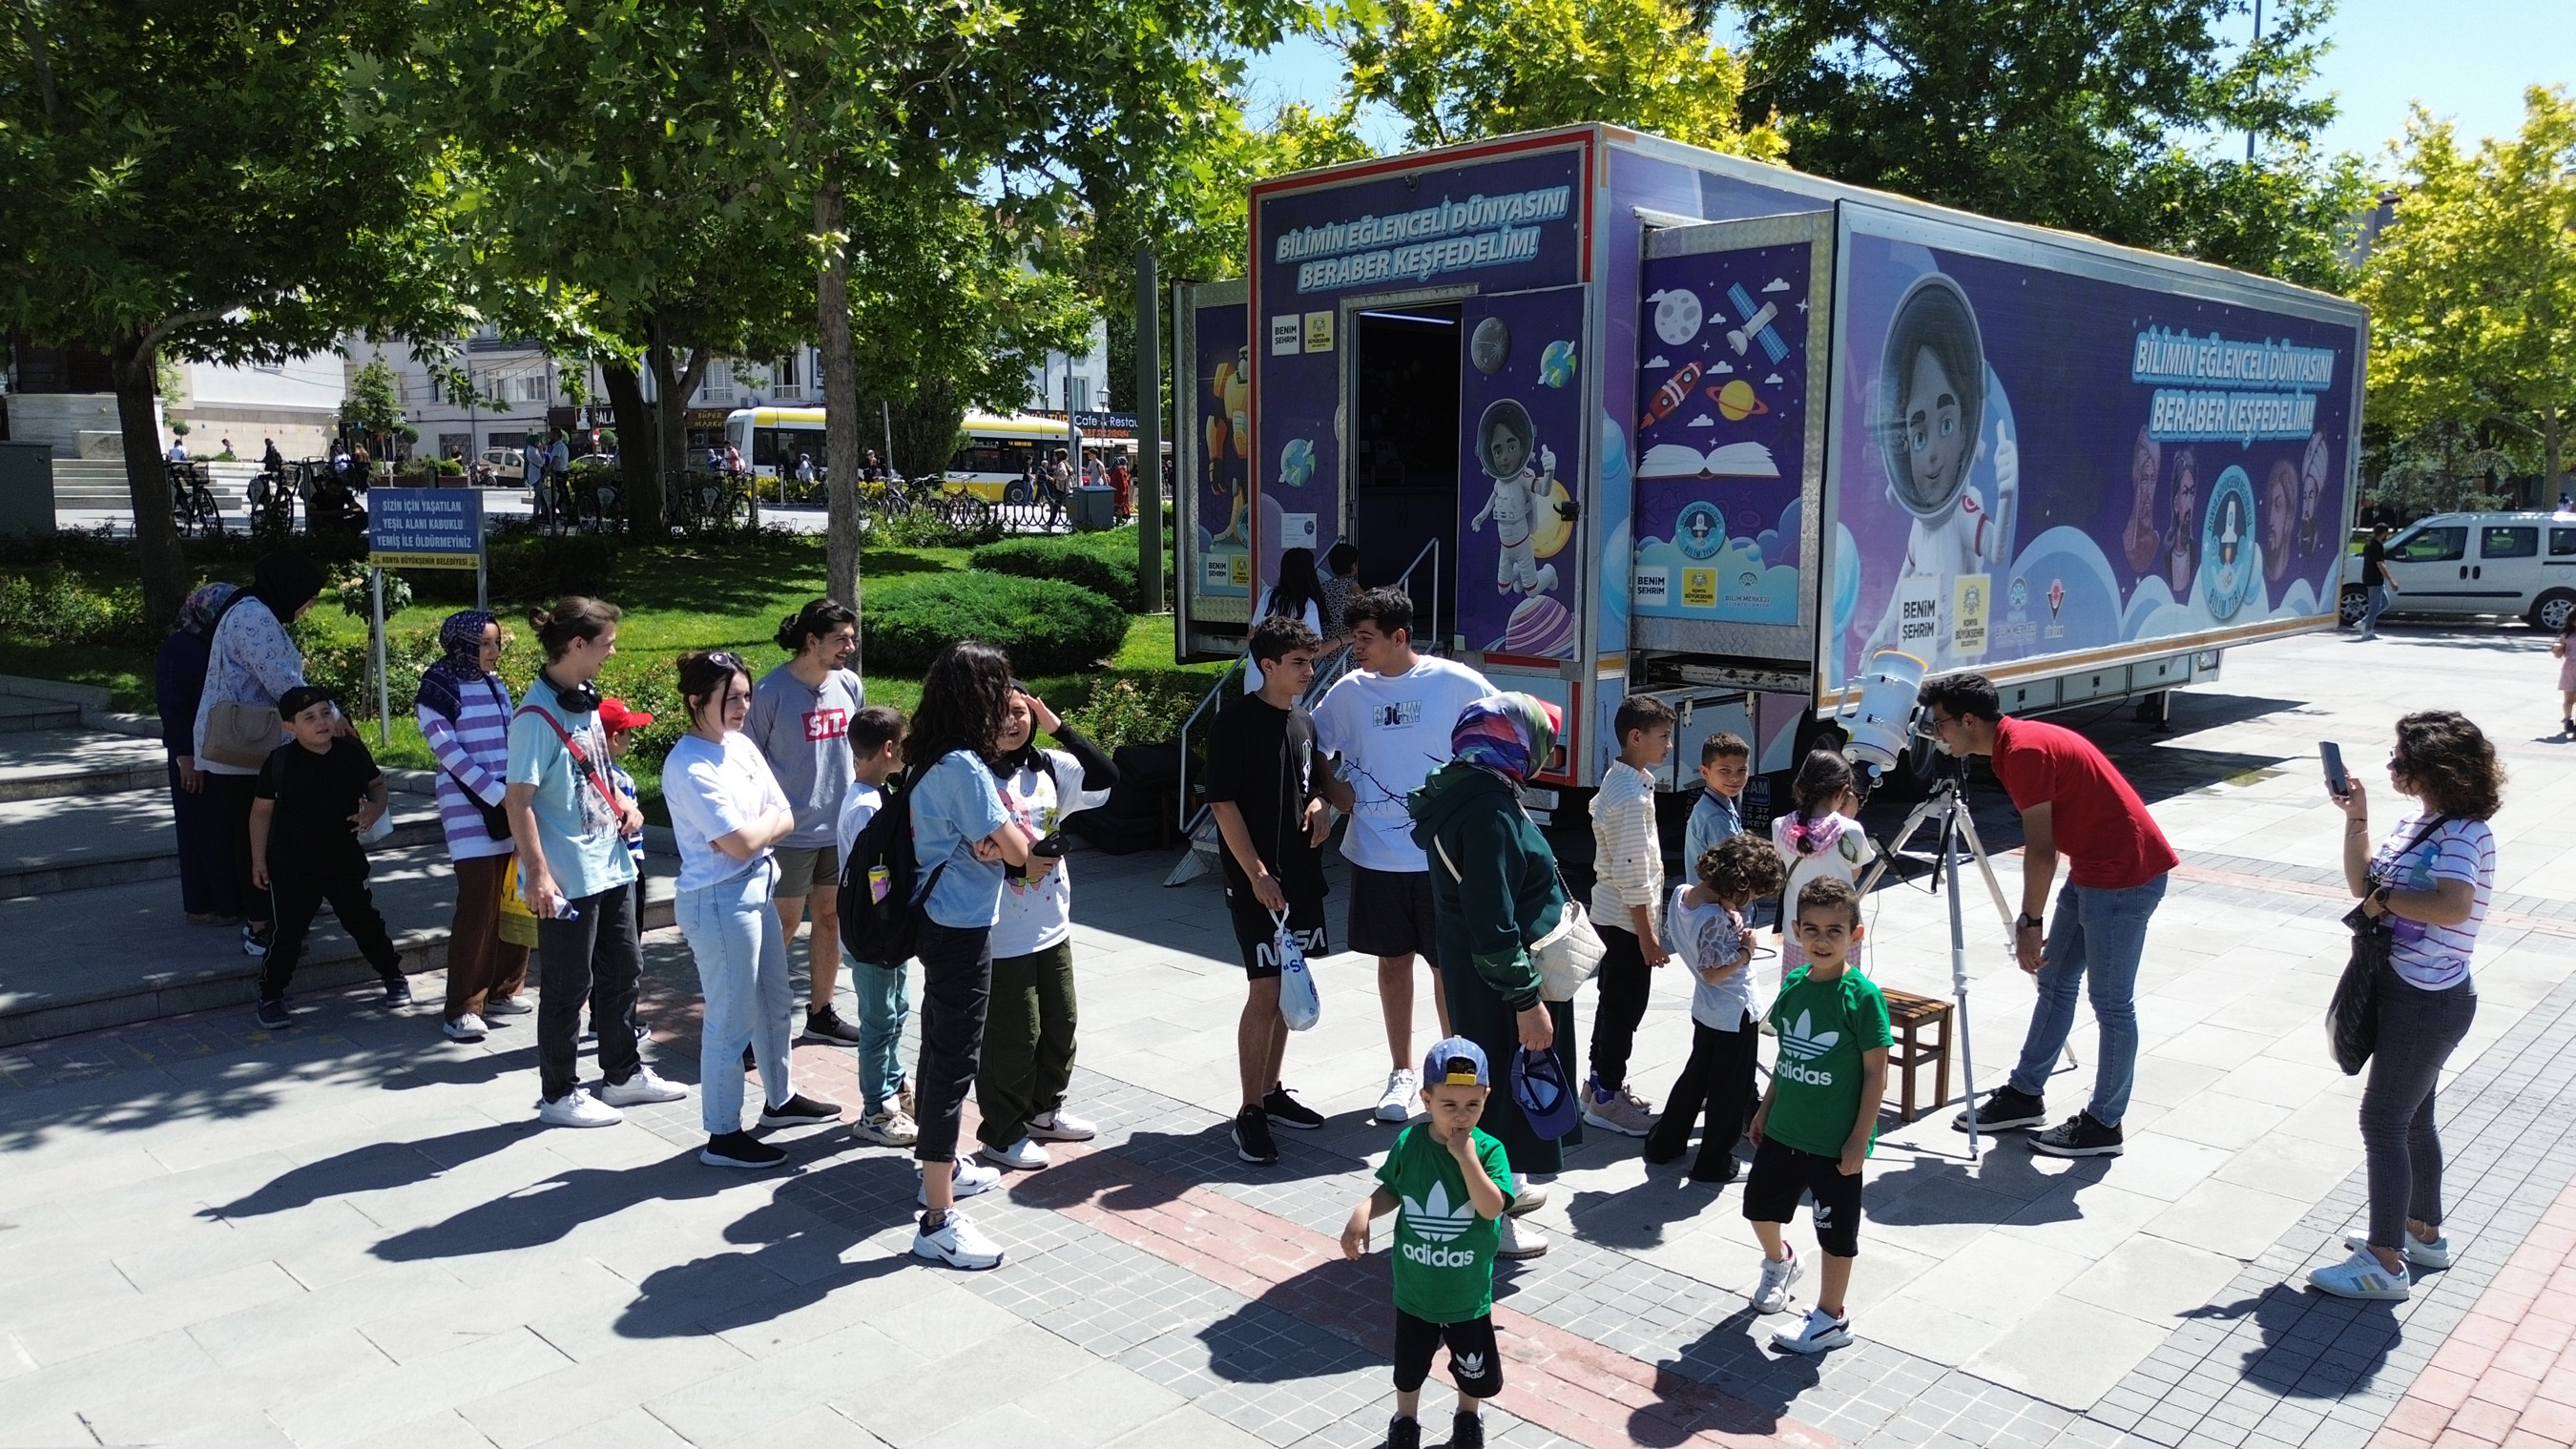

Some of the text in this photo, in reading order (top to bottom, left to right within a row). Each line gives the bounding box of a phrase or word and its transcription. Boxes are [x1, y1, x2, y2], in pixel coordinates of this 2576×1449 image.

[1278, 189, 1568, 260] BİLİMİN EĞLENCELİ DÜNYASINI
[1300, 227, 1539, 290] BERABER KEŞFEDELİM!
[2135, 332, 2333, 383] BİLİMİN EĞLENCELİ DÜNYASINI
[1074, 414, 1098, 426] Cafe
[2151, 391, 2316, 441] BERABER KEŞFEDELİM!
[383, 498, 462, 514] SİZİN İÇİN YAŞATILAN
[383, 516, 464, 532] YEŞİL ALANI KABUKLU
[377, 534, 472, 549] YEMİŞ İLE ÖLDÜRMEYİNİZ
[382, 555, 468, 567] KONYA BÜYÜKŞEHİR BELEDİYESİ
[1637, 576, 1665, 586] BENİM
[1637, 586, 1665, 595] ŞEHRİM
[1902, 599, 1936, 620] BENİM
[1901, 621, 1935, 643] ŞEHRİM
[1744, 781, 1769, 796] AM
[1256, 926, 1326, 968] NSA
[1402, 1243, 1475, 1268] adidas
[1458, 1366, 1485, 1379] adidas
